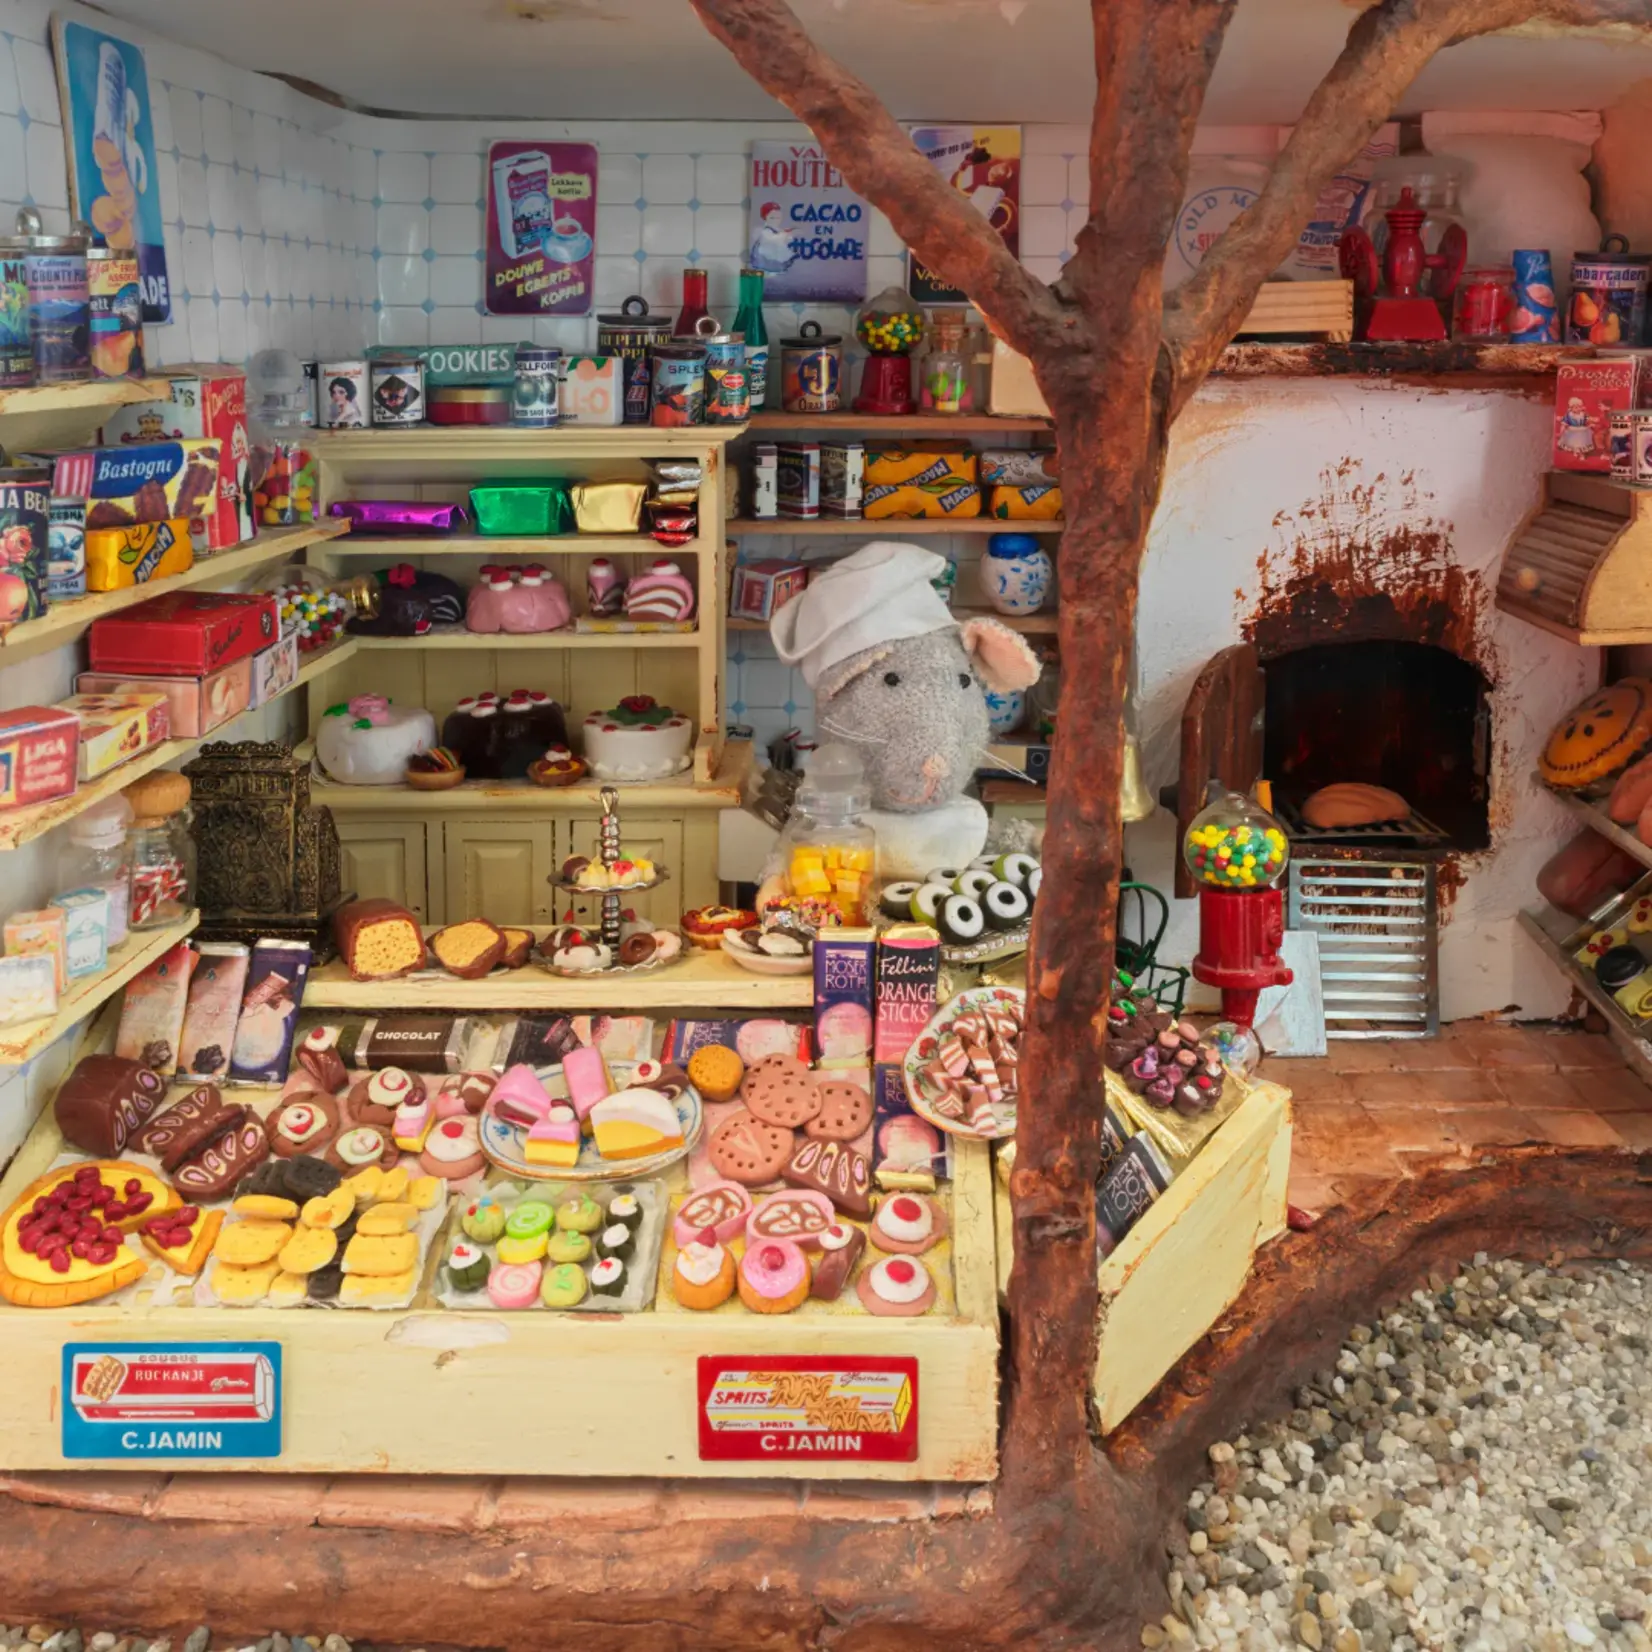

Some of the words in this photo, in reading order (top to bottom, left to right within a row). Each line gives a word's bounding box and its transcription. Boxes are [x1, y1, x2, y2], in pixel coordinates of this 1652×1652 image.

[789, 146, 824, 159] VA
[790, 203, 862, 223] CACAO
[815, 225, 833, 236] EN
[495, 259, 545, 288] DOUWE
[540, 281, 586, 308] KOFFIE
[825, 960, 867, 975] MOSER
[880, 956, 935, 976] Fellini
[879, 1002, 930, 1023] STICKS
[375, 1030, 442, 1041] CHOCOLAT
[714, 1391, 768, 1405] SPRITS
[121, 1430, 222, 1450] C.JAMIN
[760, 1434, 862, 1452] C.JAMIN
